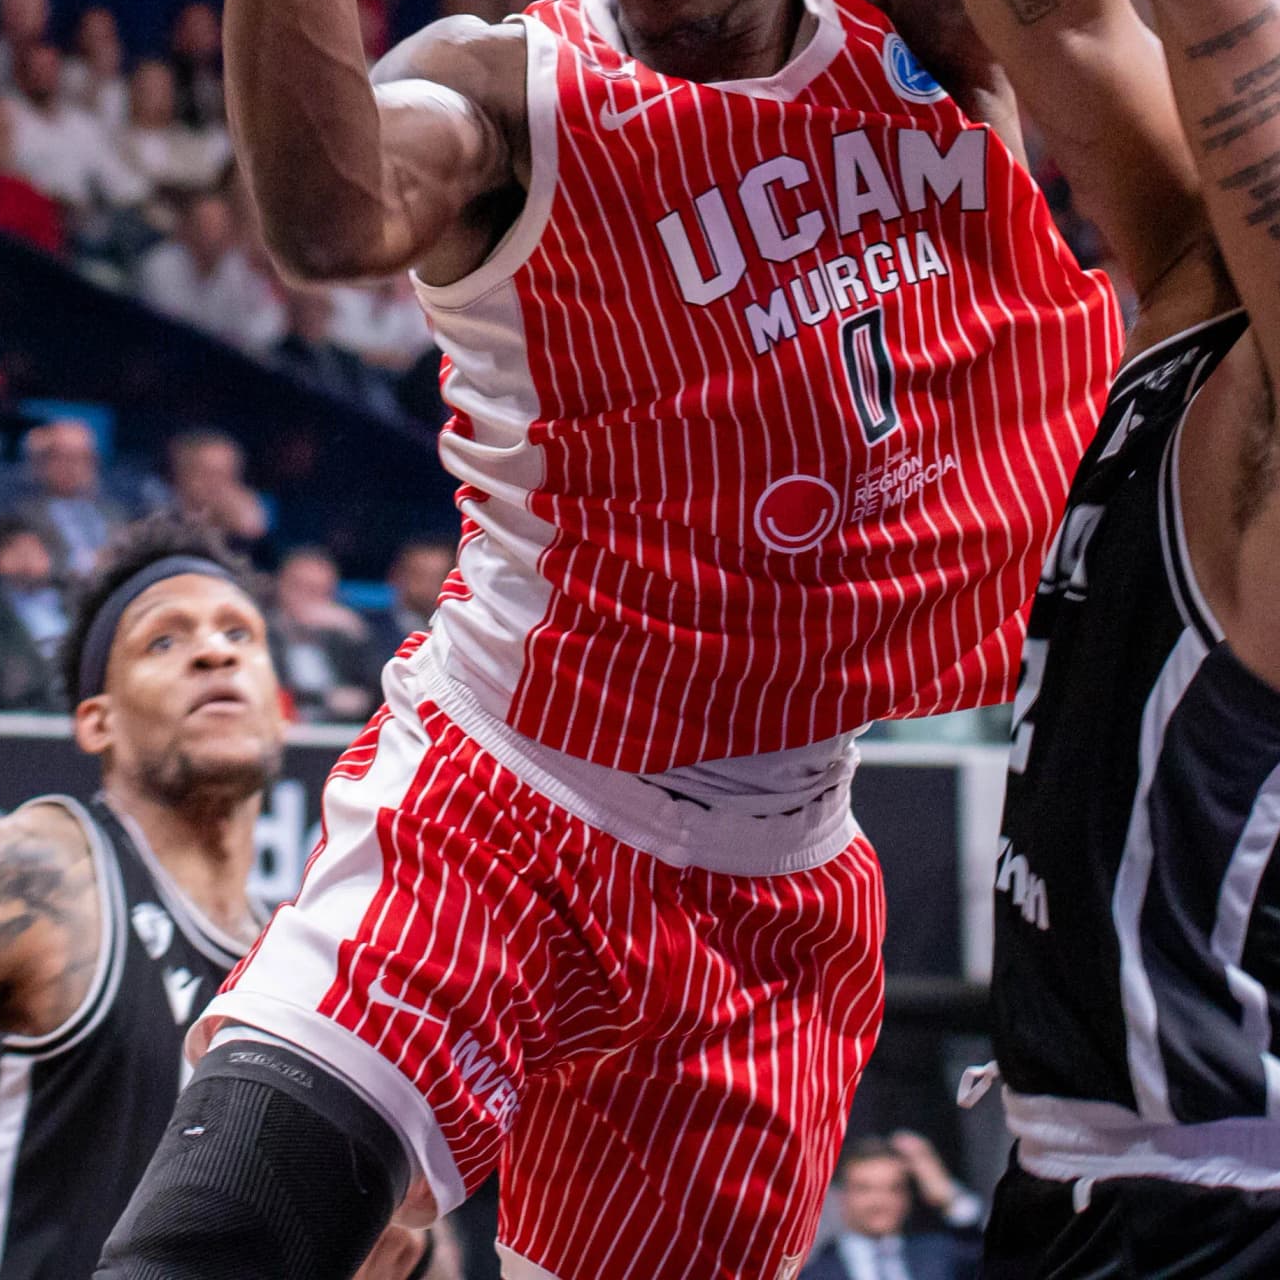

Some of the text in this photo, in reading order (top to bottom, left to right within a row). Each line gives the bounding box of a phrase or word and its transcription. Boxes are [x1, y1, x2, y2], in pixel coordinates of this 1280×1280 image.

[656, 127, 988, 307] UCAM
[744, 229, 948, 356] MURCIA
[838, 305, 903, 446] 0
[849, 499, 880, 523] DE
[884, 453, 958, 509] MURCIA
